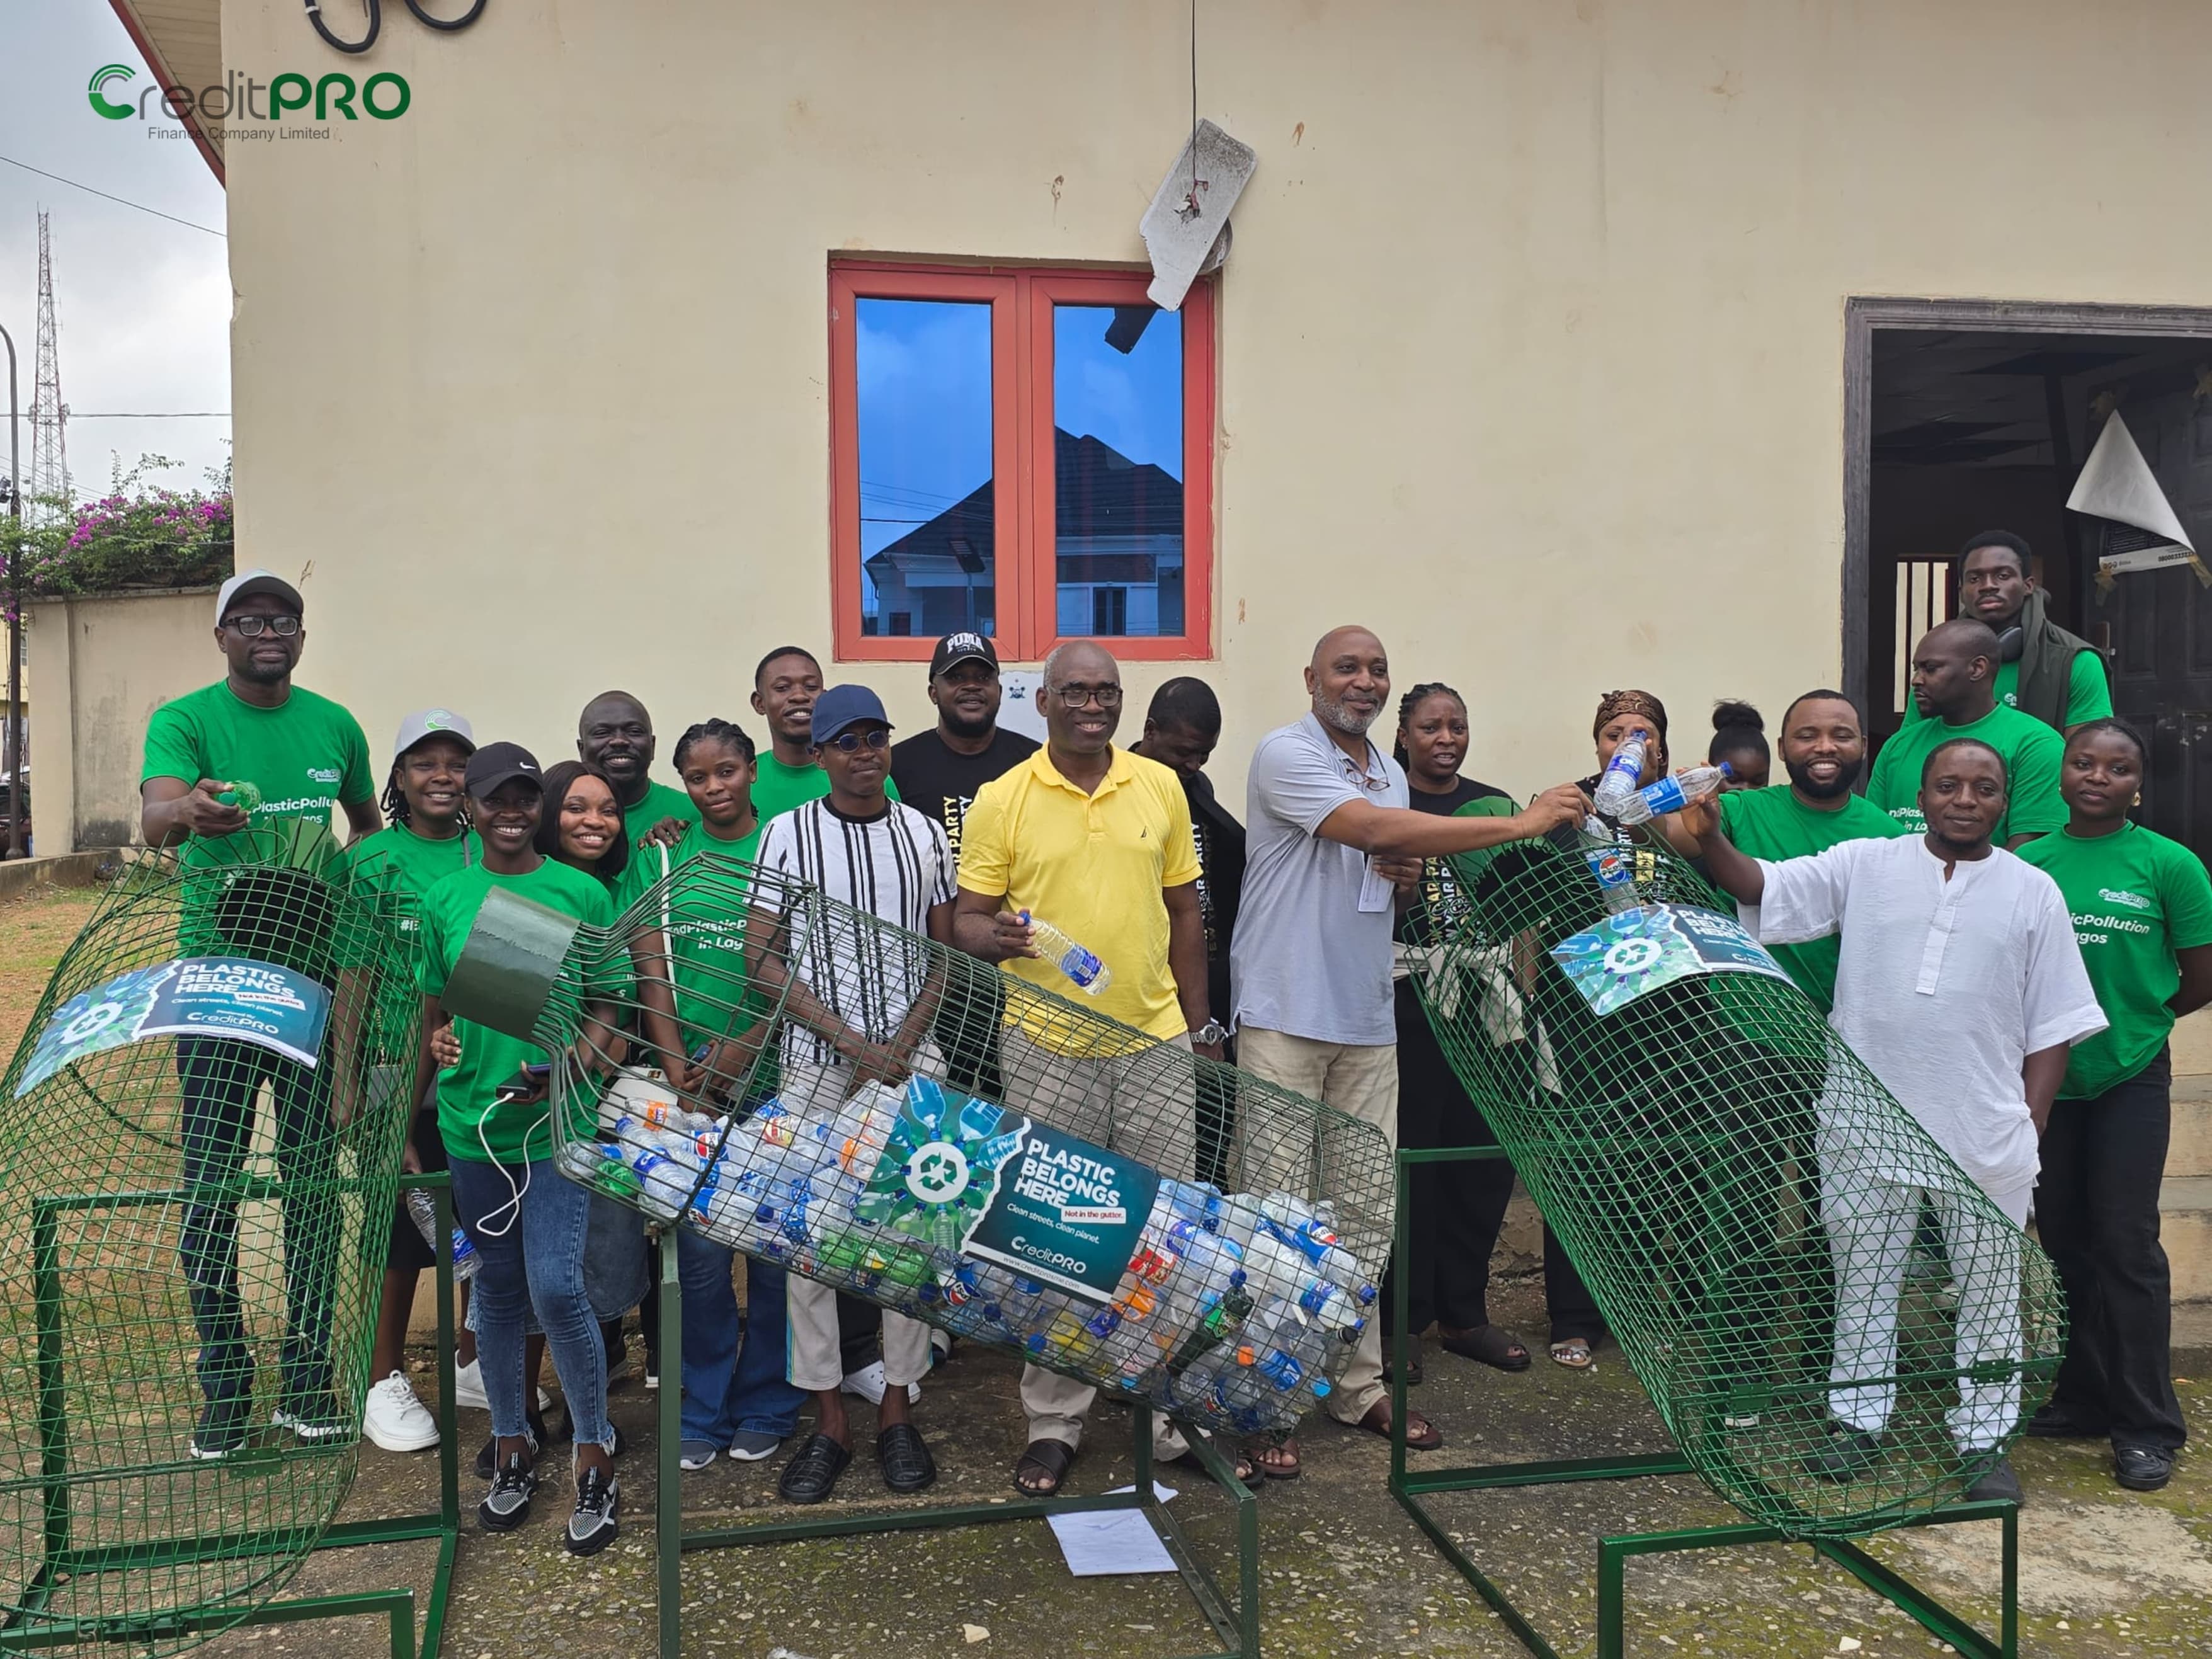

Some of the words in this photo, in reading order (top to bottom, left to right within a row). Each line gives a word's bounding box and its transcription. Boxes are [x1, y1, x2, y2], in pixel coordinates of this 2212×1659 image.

[947, 632, 985, 654] PUMA
[944, 796, 961, 848] PARTY
[178, 974, 296, 998] BELONGS
[182, 964, 287, 984] PLASTIC
[174, 983, 240, 994] HERE
[187, 1012, 280, 1034] CreditPRO
[1027, 1138, 1115, 1185] PLASTIC
[1013, 1177, 1070, 1209] HERE
[1021, 1157, 1120, 1207] BELONGS
[1007, 1202, 1029, 1217] Clean
[1028, 1212, 1054, 1228] streets,
[1055, 1222, 1076, 1234] clean
[1075, 1229, 1100, 1245] planet.
[1086, 1210, 1099, 1218] the
[1100, 1211, 1124, 1219] gutter.
[1011, 1236, 1087, 1274] CreditPRO
